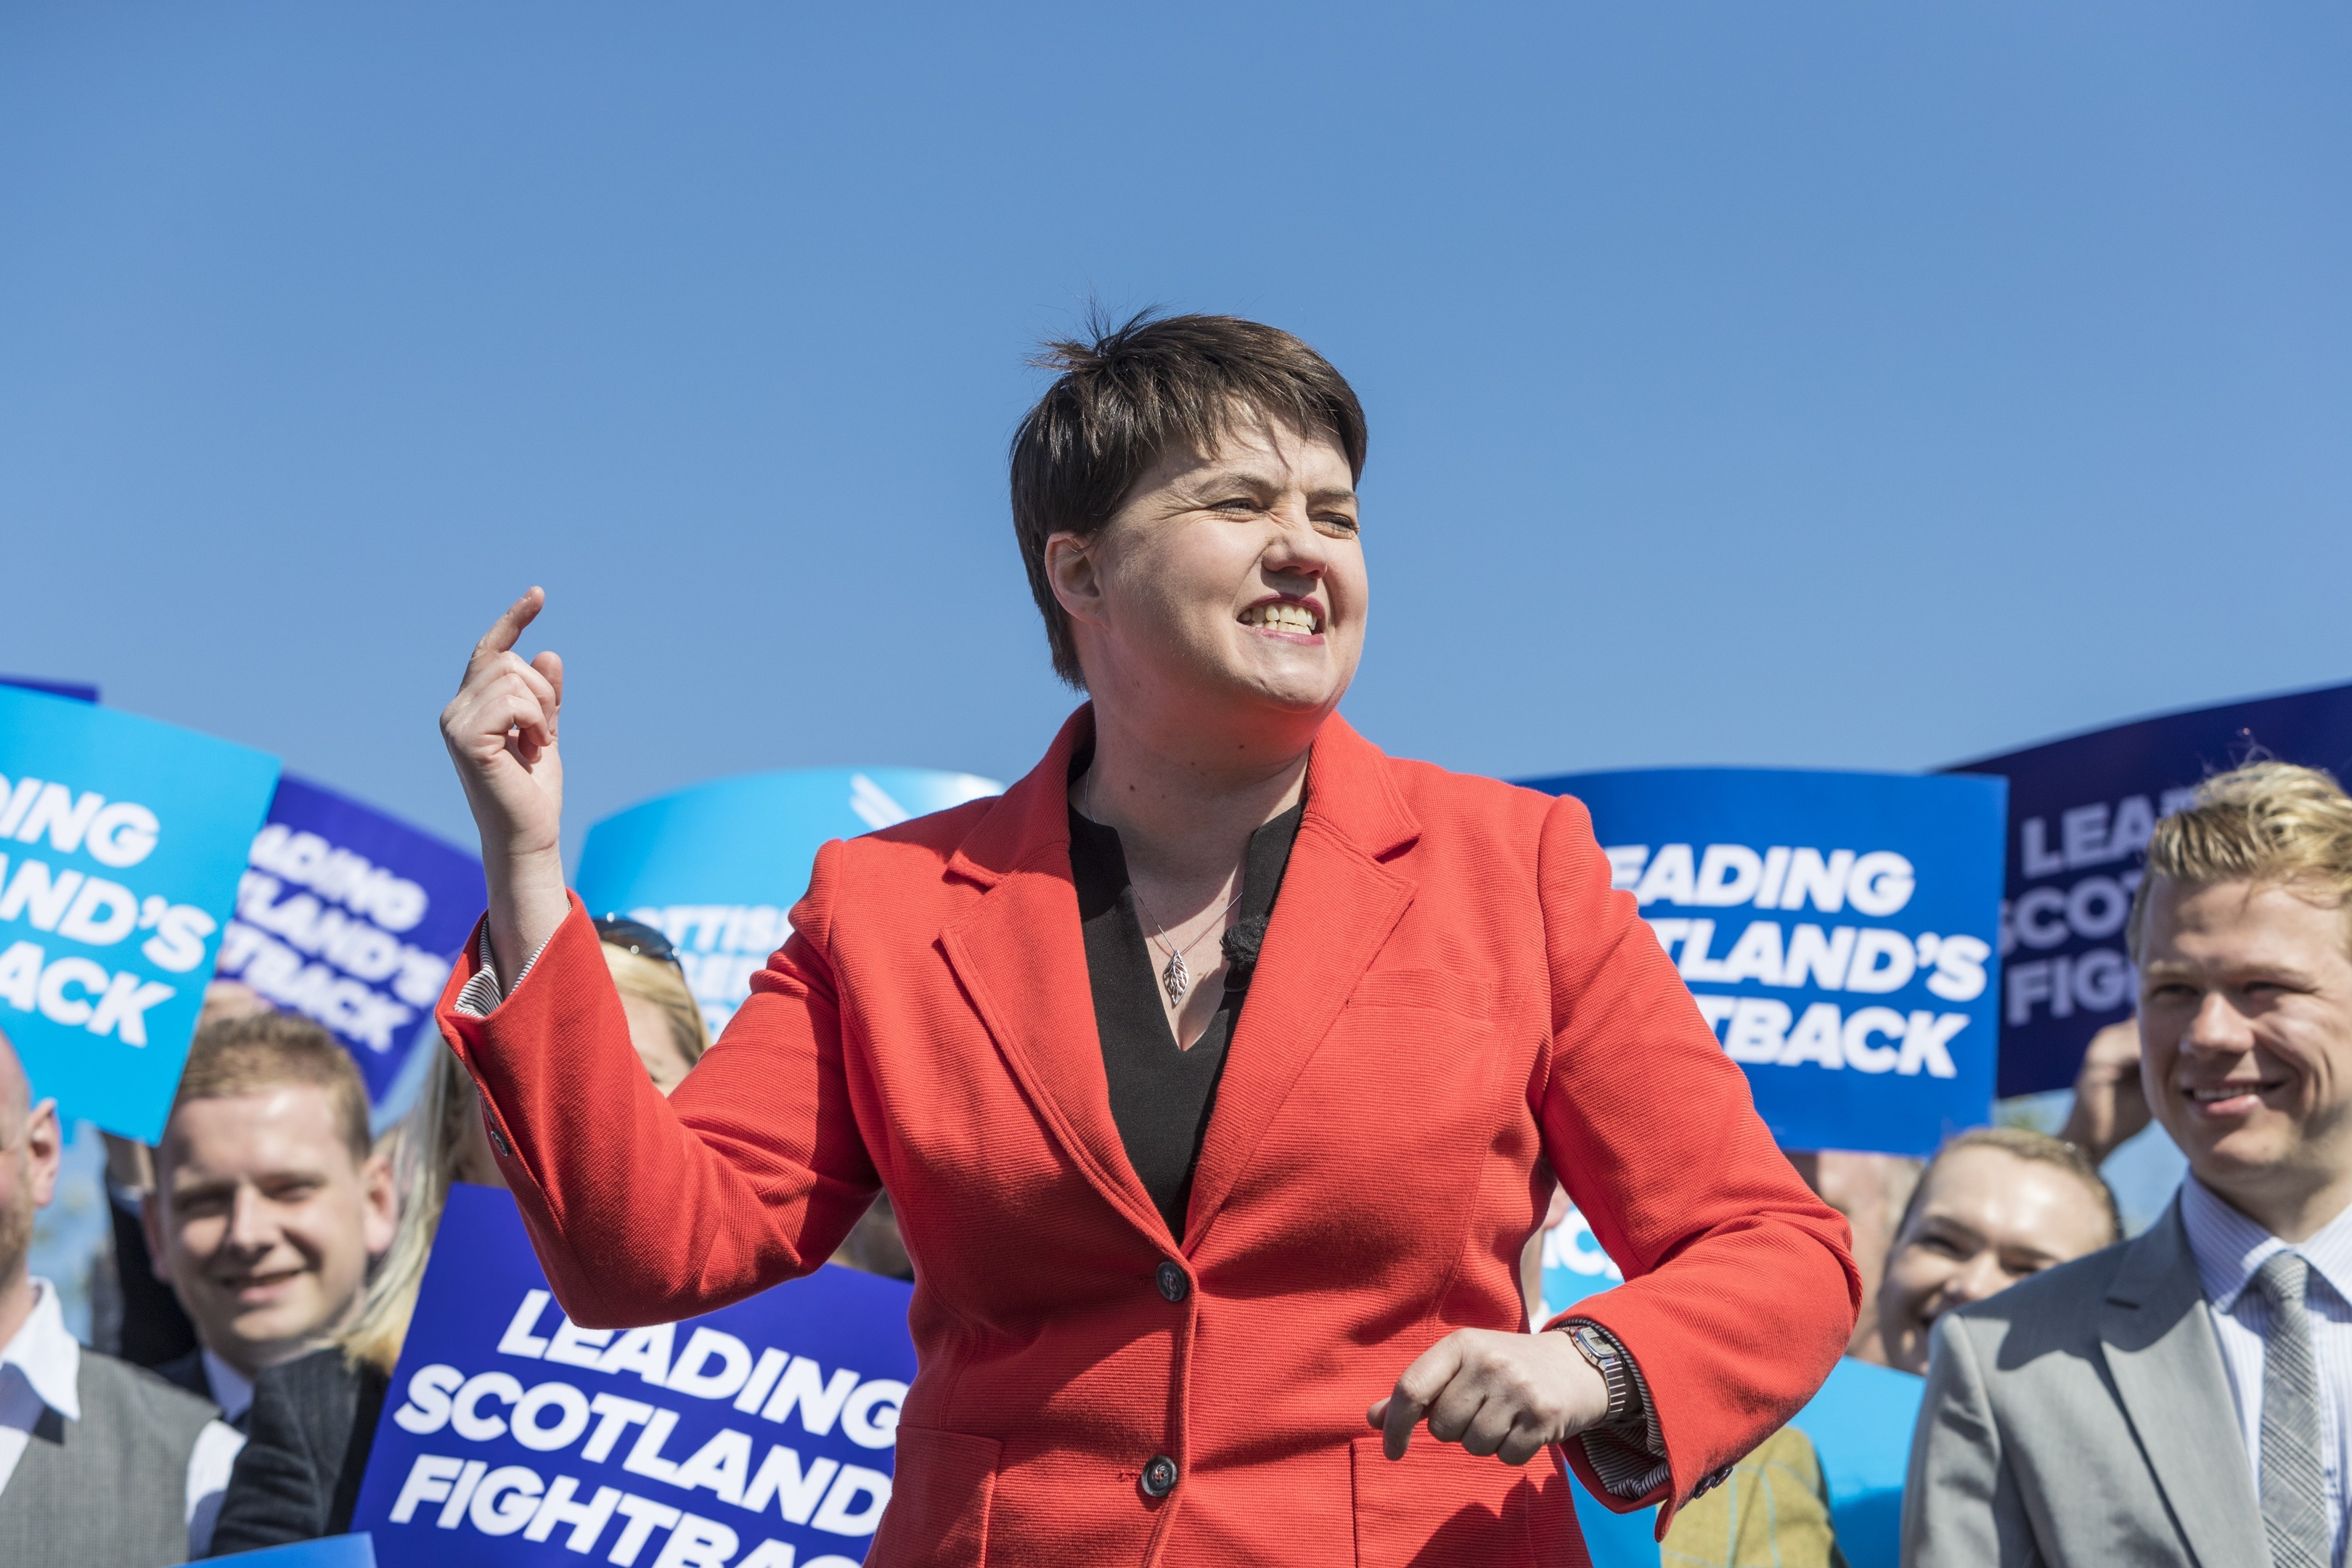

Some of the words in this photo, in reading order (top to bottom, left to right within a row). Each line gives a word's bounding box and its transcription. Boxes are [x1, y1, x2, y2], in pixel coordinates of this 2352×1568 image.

[0, 772, 160, 868] ING
[0, 847, 217, 973] ND'S
[497, 1288, 911, 1450] LEADING
[388, 1453, 865, 1568] FIGHTB
[393, 1363, 894, 1538] SCOTLAND
